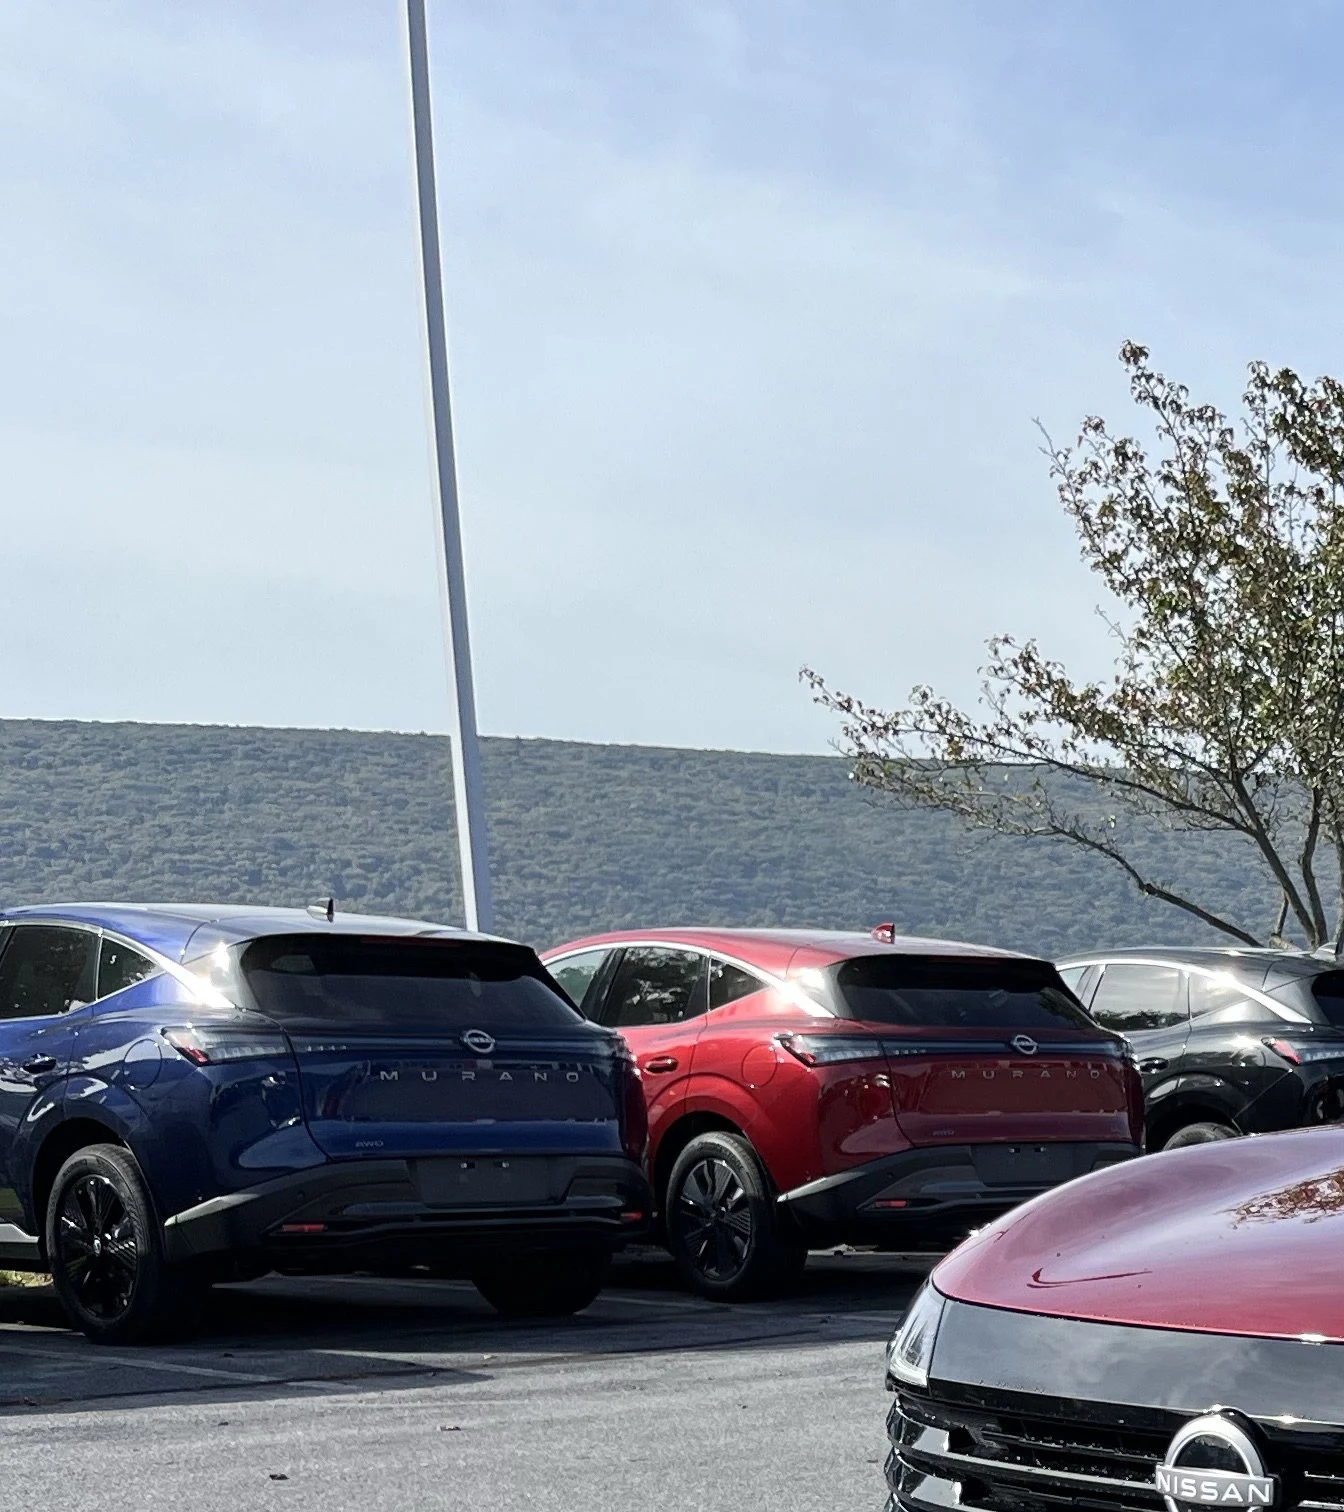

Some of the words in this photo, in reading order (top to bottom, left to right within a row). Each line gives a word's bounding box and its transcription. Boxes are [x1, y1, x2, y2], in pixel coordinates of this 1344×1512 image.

[380, 1071, 580, 1082] MURANO
[951, 1070, 1100, 1079] MURANO
[1156, 1470, 1271, 1503] NISSAN
